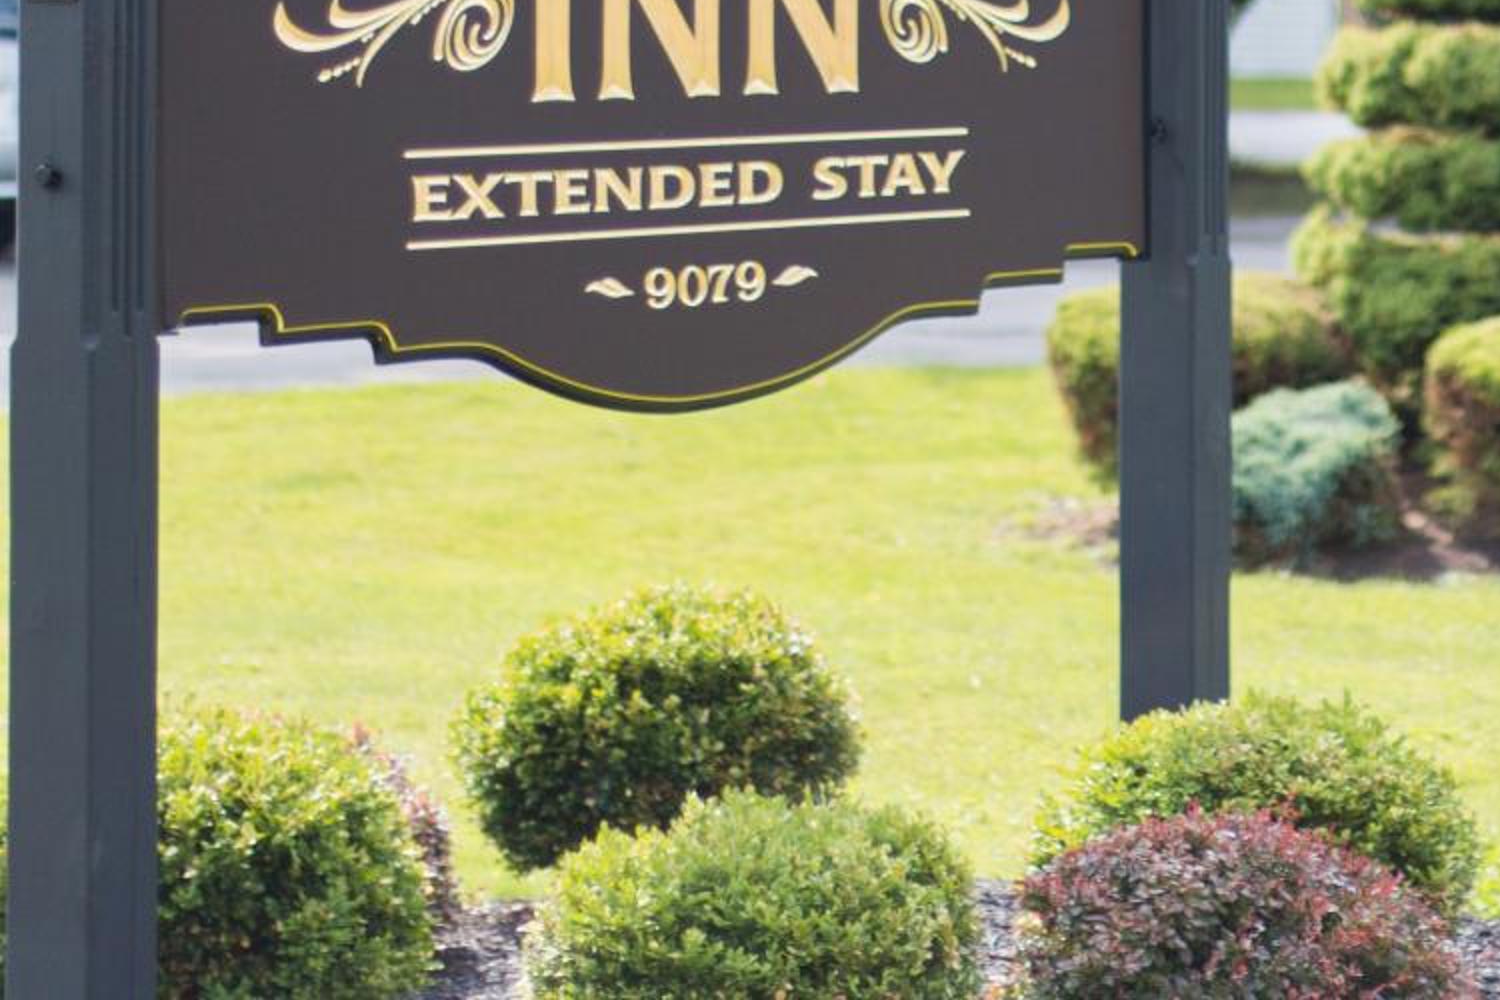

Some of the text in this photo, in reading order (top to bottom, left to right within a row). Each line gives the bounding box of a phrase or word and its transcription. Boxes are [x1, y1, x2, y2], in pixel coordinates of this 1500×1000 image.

[412, 150, 965, 222] EXTENDED STAY
[643, 260, 767, 309] 9079
